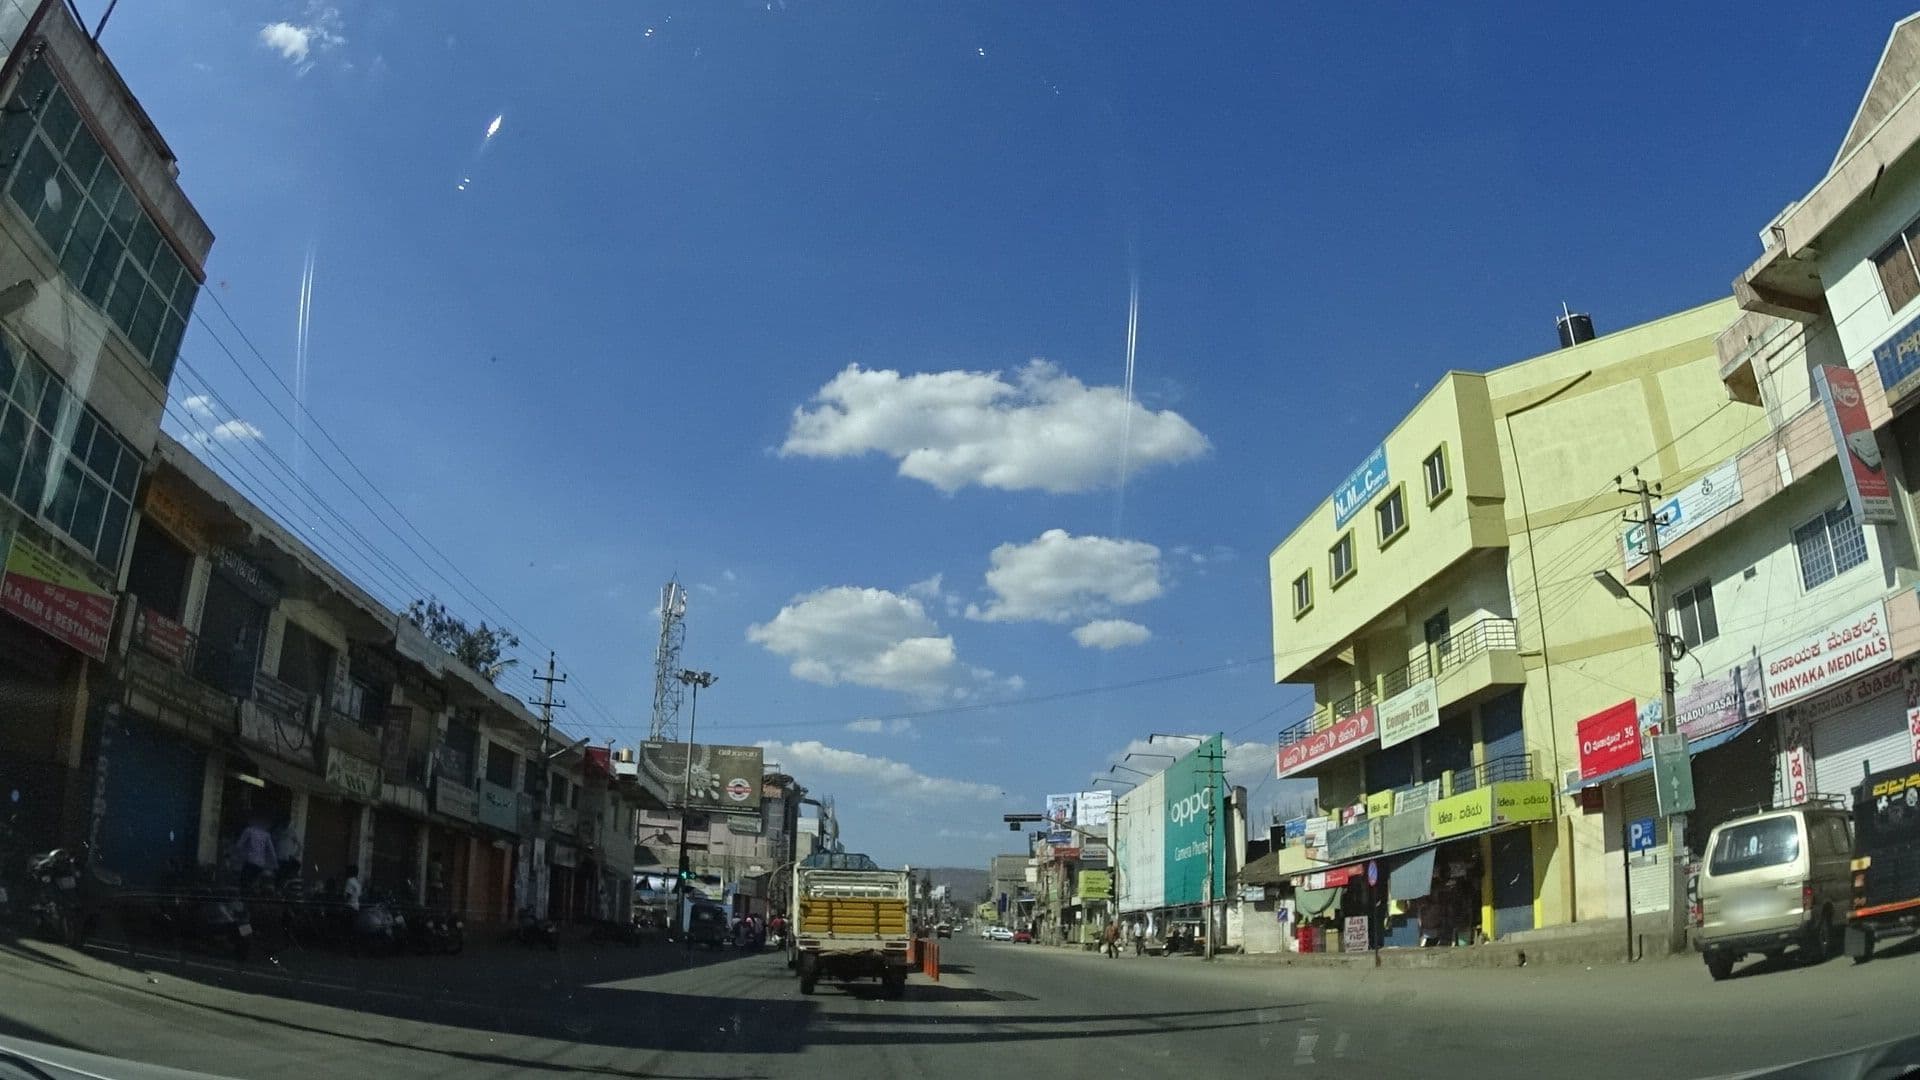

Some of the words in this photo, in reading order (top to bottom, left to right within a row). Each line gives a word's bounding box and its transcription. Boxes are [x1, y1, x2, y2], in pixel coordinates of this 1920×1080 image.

[1769, 665, 1826, 698] VINAYAKA
[1827, 637, 1887, 675] MEDICALS
[1630, 823, 1643, 848] P
